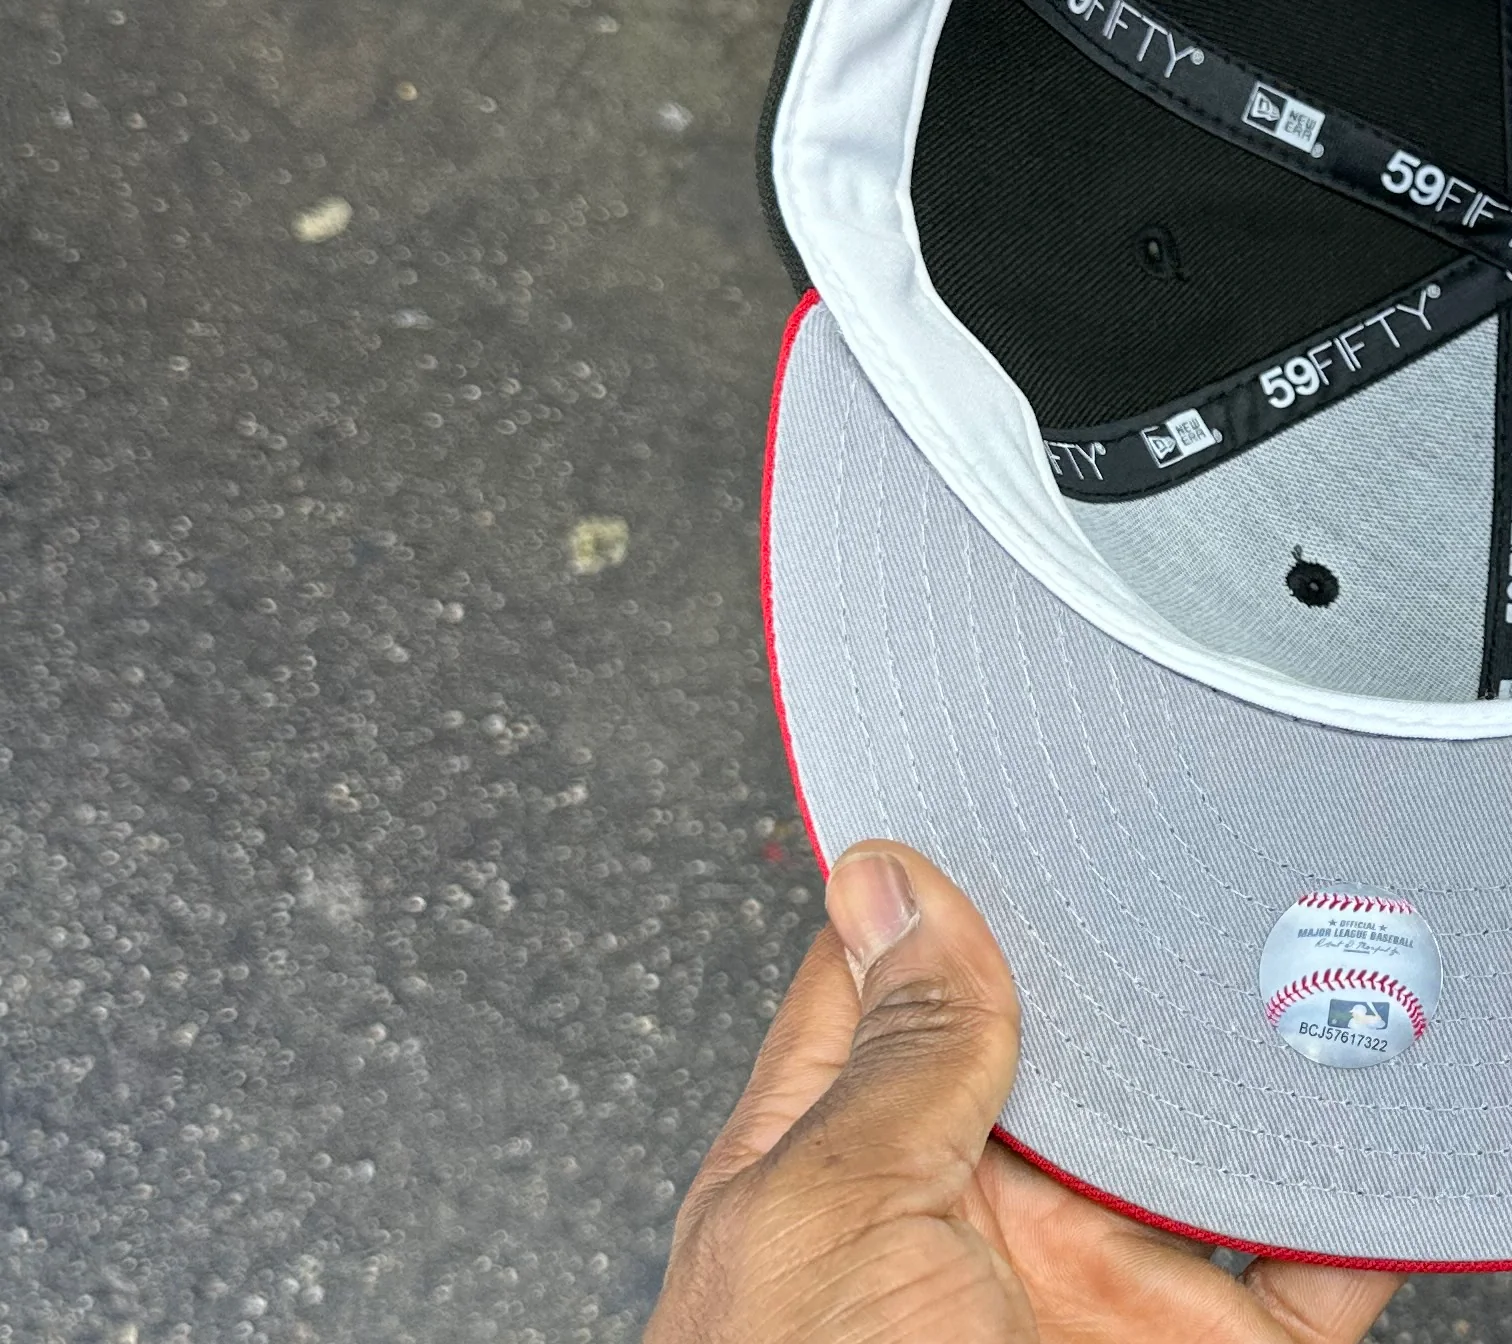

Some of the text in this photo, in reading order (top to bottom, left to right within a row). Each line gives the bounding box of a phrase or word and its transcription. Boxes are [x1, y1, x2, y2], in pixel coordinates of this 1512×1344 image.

[1258, 291, 1434, 409] 59FIFTY
[1297, 927, 1332, 938] MAJOR
[1334, 928, 1369, 940] LEAGUE
[1369, 931, 1414, 949] BASEBALL
[1340, 919, 1376, 931] OFFICIAL
[1298, 1021, 1389, 1053] BCJ57617322
